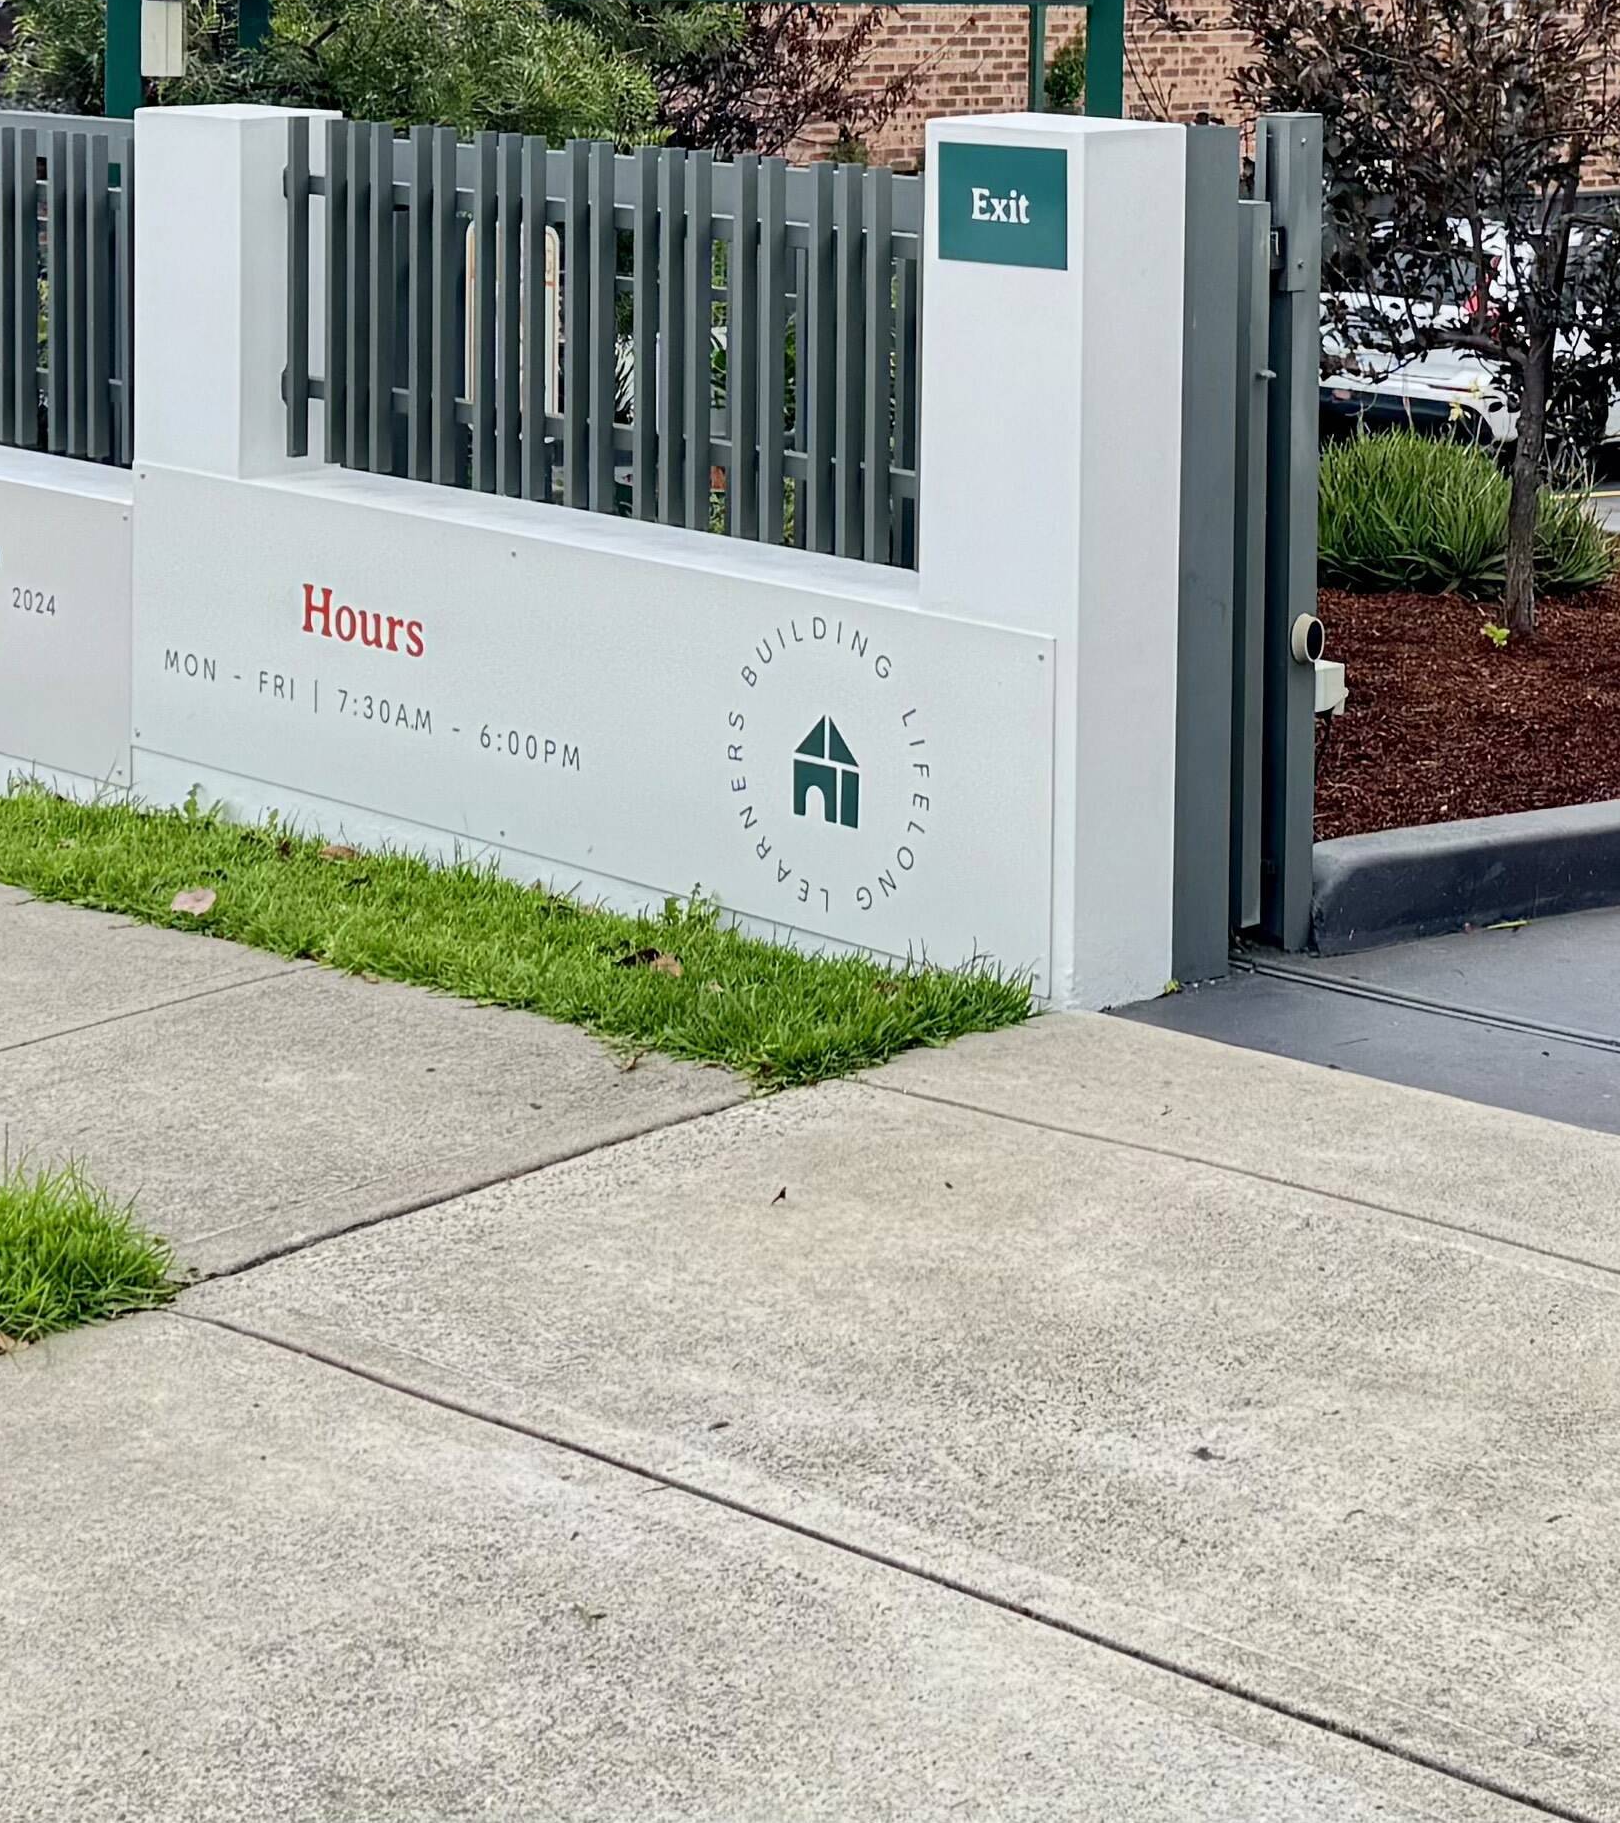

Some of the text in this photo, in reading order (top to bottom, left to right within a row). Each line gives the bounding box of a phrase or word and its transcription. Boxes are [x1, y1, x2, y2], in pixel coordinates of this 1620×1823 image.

[971, 187, 1031, 225] Exit
[12, 586, 57, 617] 2024
[302, 583, 425, 658] Hours
[164, 648, 217, 682] MON
[258, 670, 295, 701] FRI
[479, 724, 581, 771] 6:00PM
[727, 616, 930, 914] BUILDING LIFELONG LEARNERS
